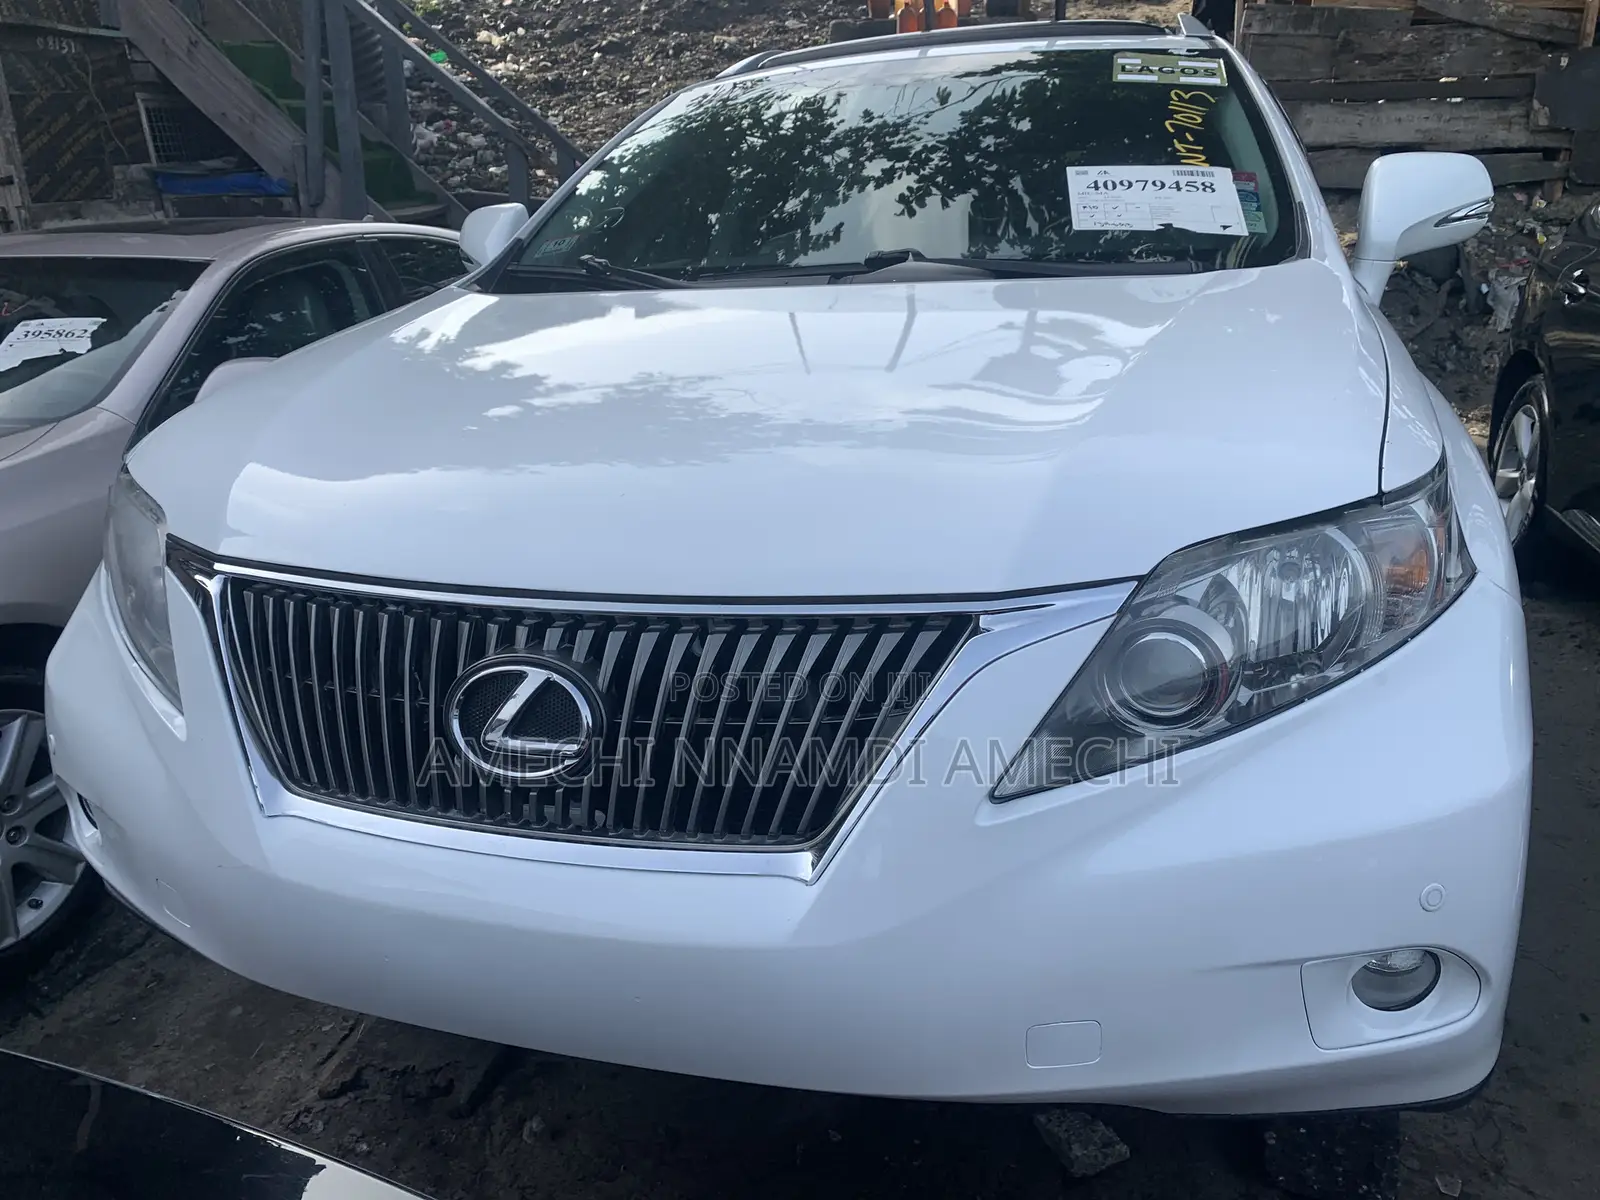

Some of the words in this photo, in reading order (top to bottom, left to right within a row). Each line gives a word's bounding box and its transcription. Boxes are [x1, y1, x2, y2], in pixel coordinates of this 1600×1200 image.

[1120, 64, 1217, 77] LAGOS
[1086, 179, 1217, 194] 40979458
[17, 328, 91, 340] 395862
